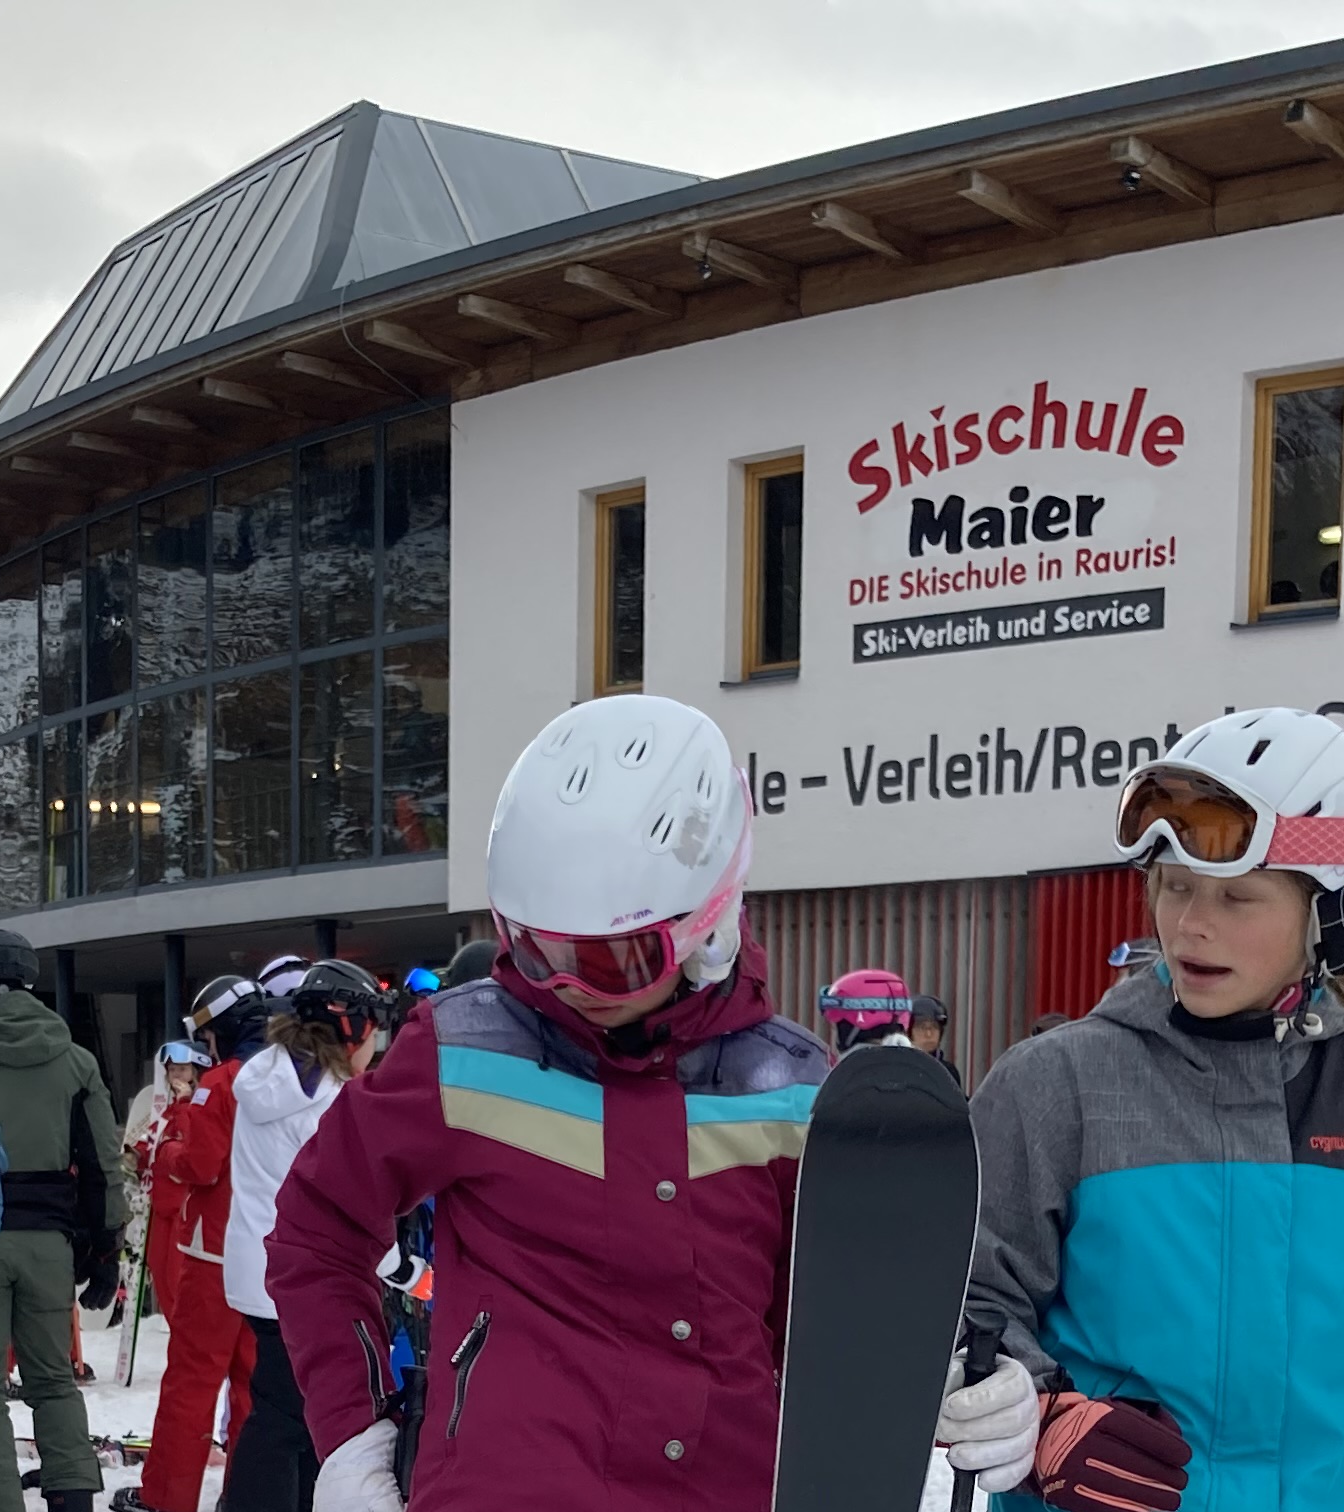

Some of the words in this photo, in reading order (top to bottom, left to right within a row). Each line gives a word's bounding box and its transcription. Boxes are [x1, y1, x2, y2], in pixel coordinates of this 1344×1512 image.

[848, 381, 1184, 514] Skischule
[909, 486, 1105, 557] Maier
[849, 575, 890, 606] DIE
[899, 557, 1027, 600] Skischule
[1038, 553, 1063, 582] in
[1075, 536, 1176, 577] Rauris!
[861, 617, 991, 657] Ski-Verleih
[997, 609, 1046, 640] und
[1054, 600, 1151, 635] Service
